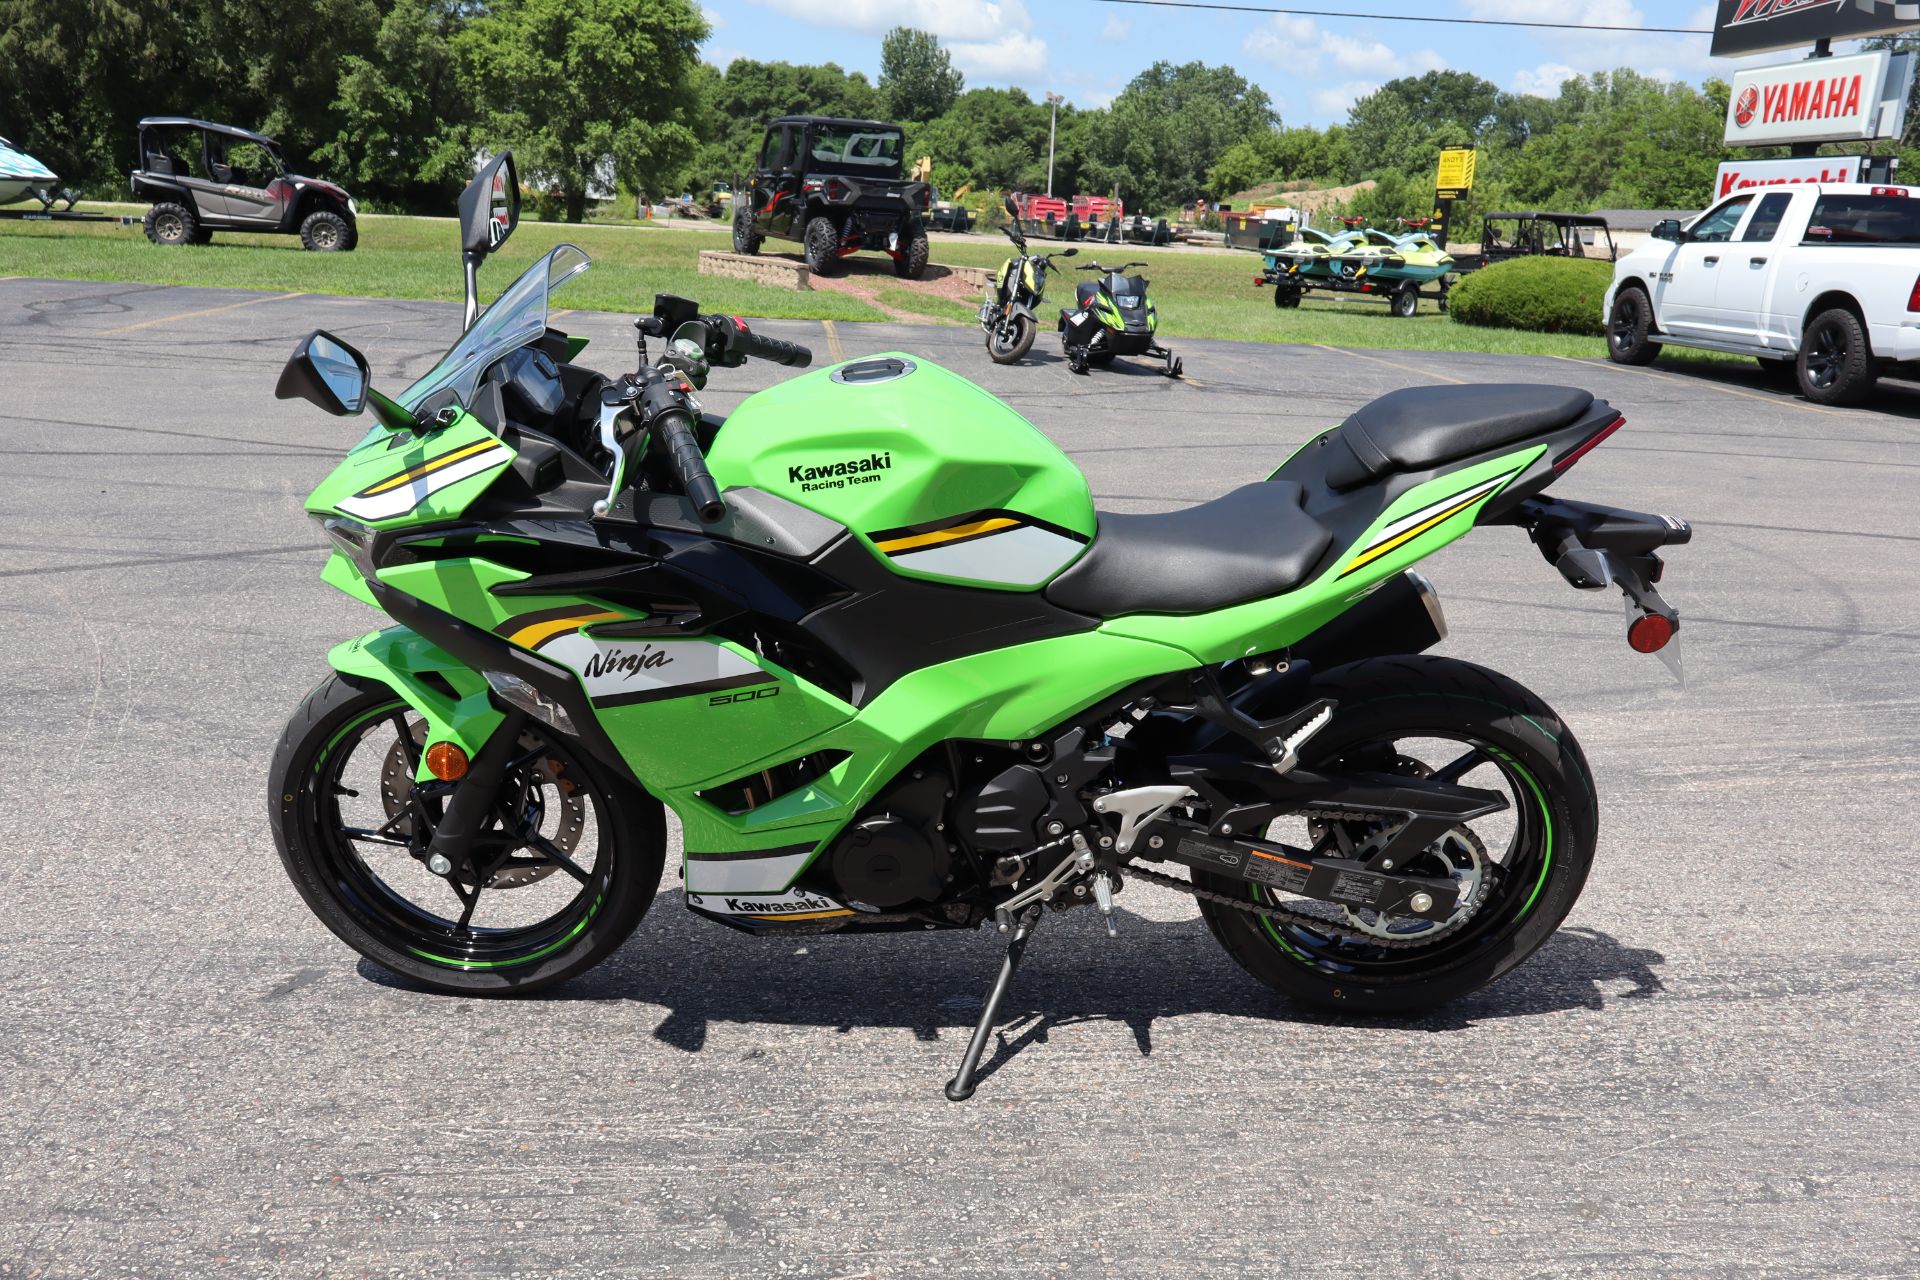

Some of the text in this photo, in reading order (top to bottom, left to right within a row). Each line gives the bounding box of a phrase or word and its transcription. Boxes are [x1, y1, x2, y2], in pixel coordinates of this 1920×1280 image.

[1762, 74, 1863, 124] YAMAHA
[788, 452, 891, 483] Kawasaki
[801, 474, 881, 492] Racing Team
[583, 643, 674, 682] Ninja
[709, 687, 780, 706] 500
[724, 896, 831, 913] Kawasaki
